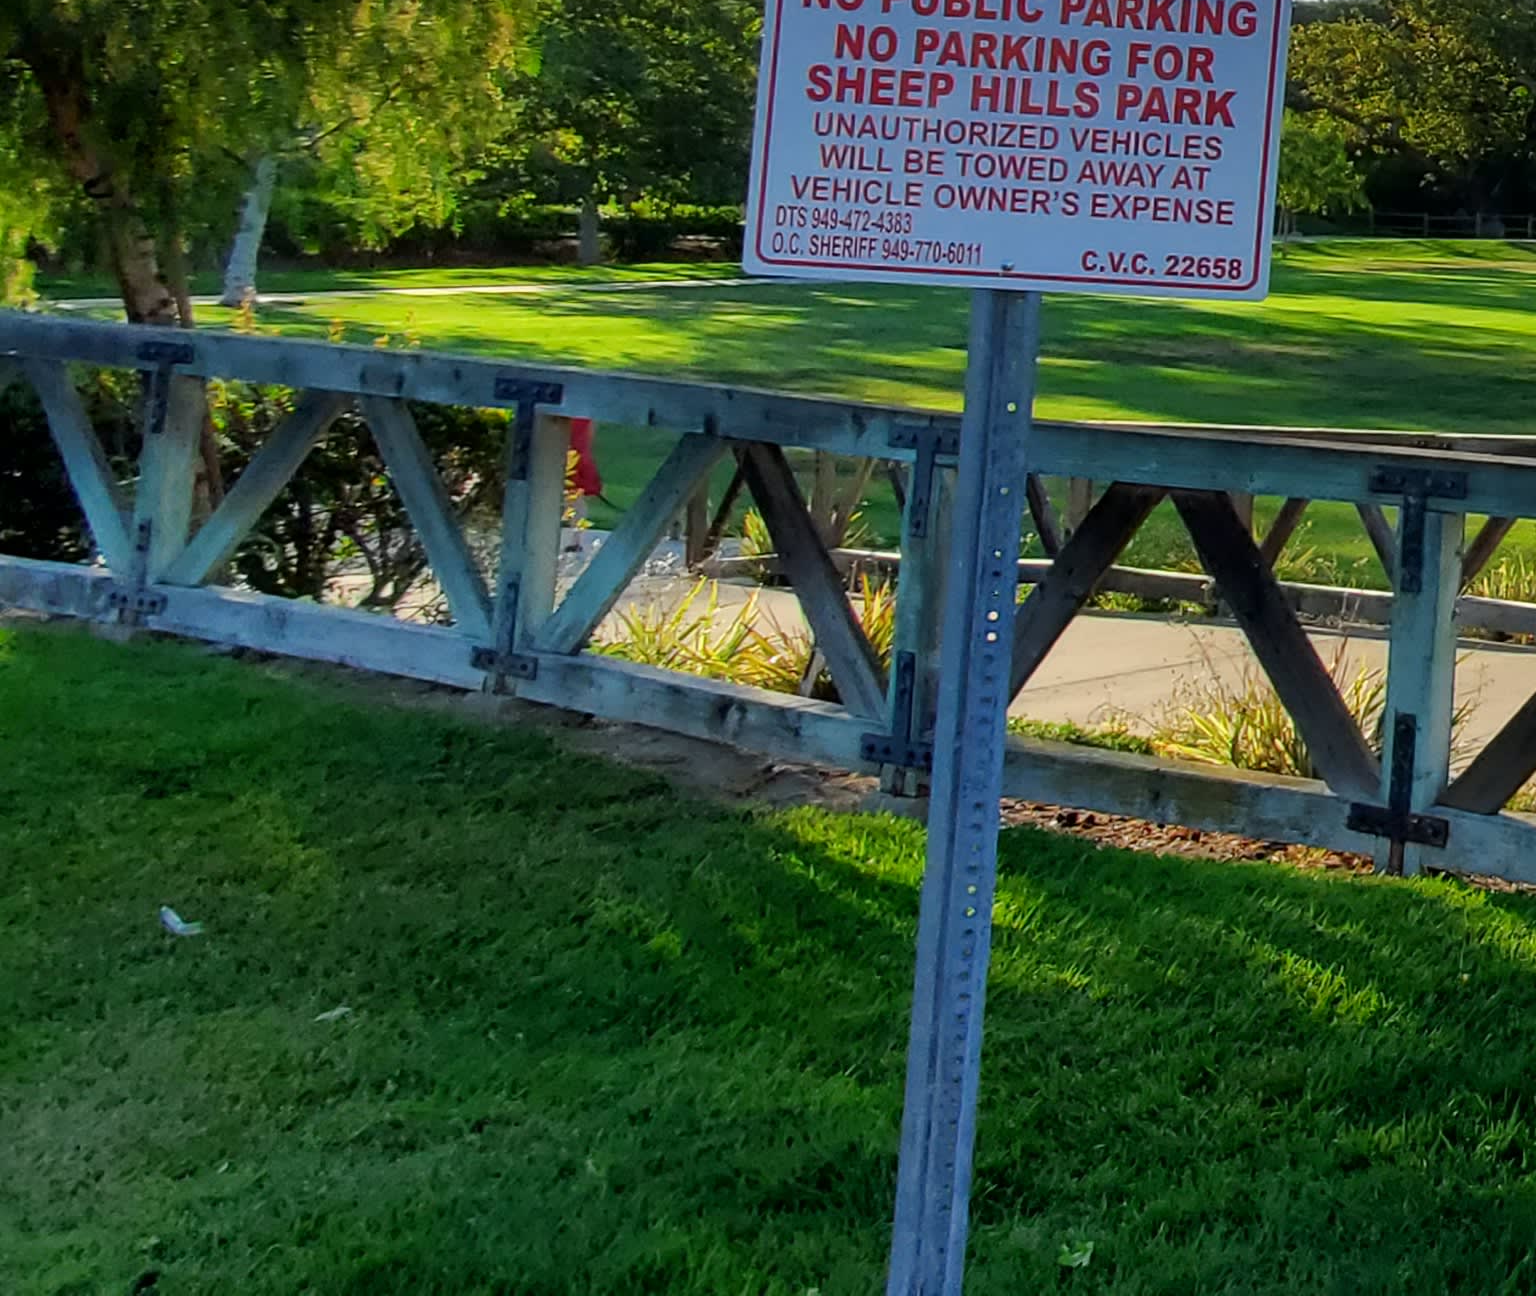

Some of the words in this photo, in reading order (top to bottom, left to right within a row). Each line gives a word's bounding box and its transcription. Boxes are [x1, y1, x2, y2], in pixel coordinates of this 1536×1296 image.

[834, 23, 898, 62] NO
[914, 29, 1111, 77] PARKING
[1127, 42, 1215, 83] FOR
[806, 64, 954, 108] SHEEP
[970, 74, 1100, 120] HILLS
[1116, 84, 1237, 127] PARK
[814, 111, 1058, 151] UNAUTHORIZED
[1071, 128, 1223, 161] VEHICLES
[819, 144, 892, 173] WILL
[903, 150, 944, 176] BE
[955, 152, 1068, 183] TOWED
[1077, 159, 1165, 189] AWAY
[1170, 165, 1211, 191] AT
[775, 205, 807, 228] DTS
[791, 175, 923, 207] VEHICLE
[1090, 194, 1235, 226] EXPENSE
[772, 232, 803, 256] O.C.
[809, 234, 877, 259] SHERIFF
[881, 240, 983, 266] 949-770-6011
[1080, 250, 1156, 276] C.V.C.
[1164, 254, 1242, 280] 22658
